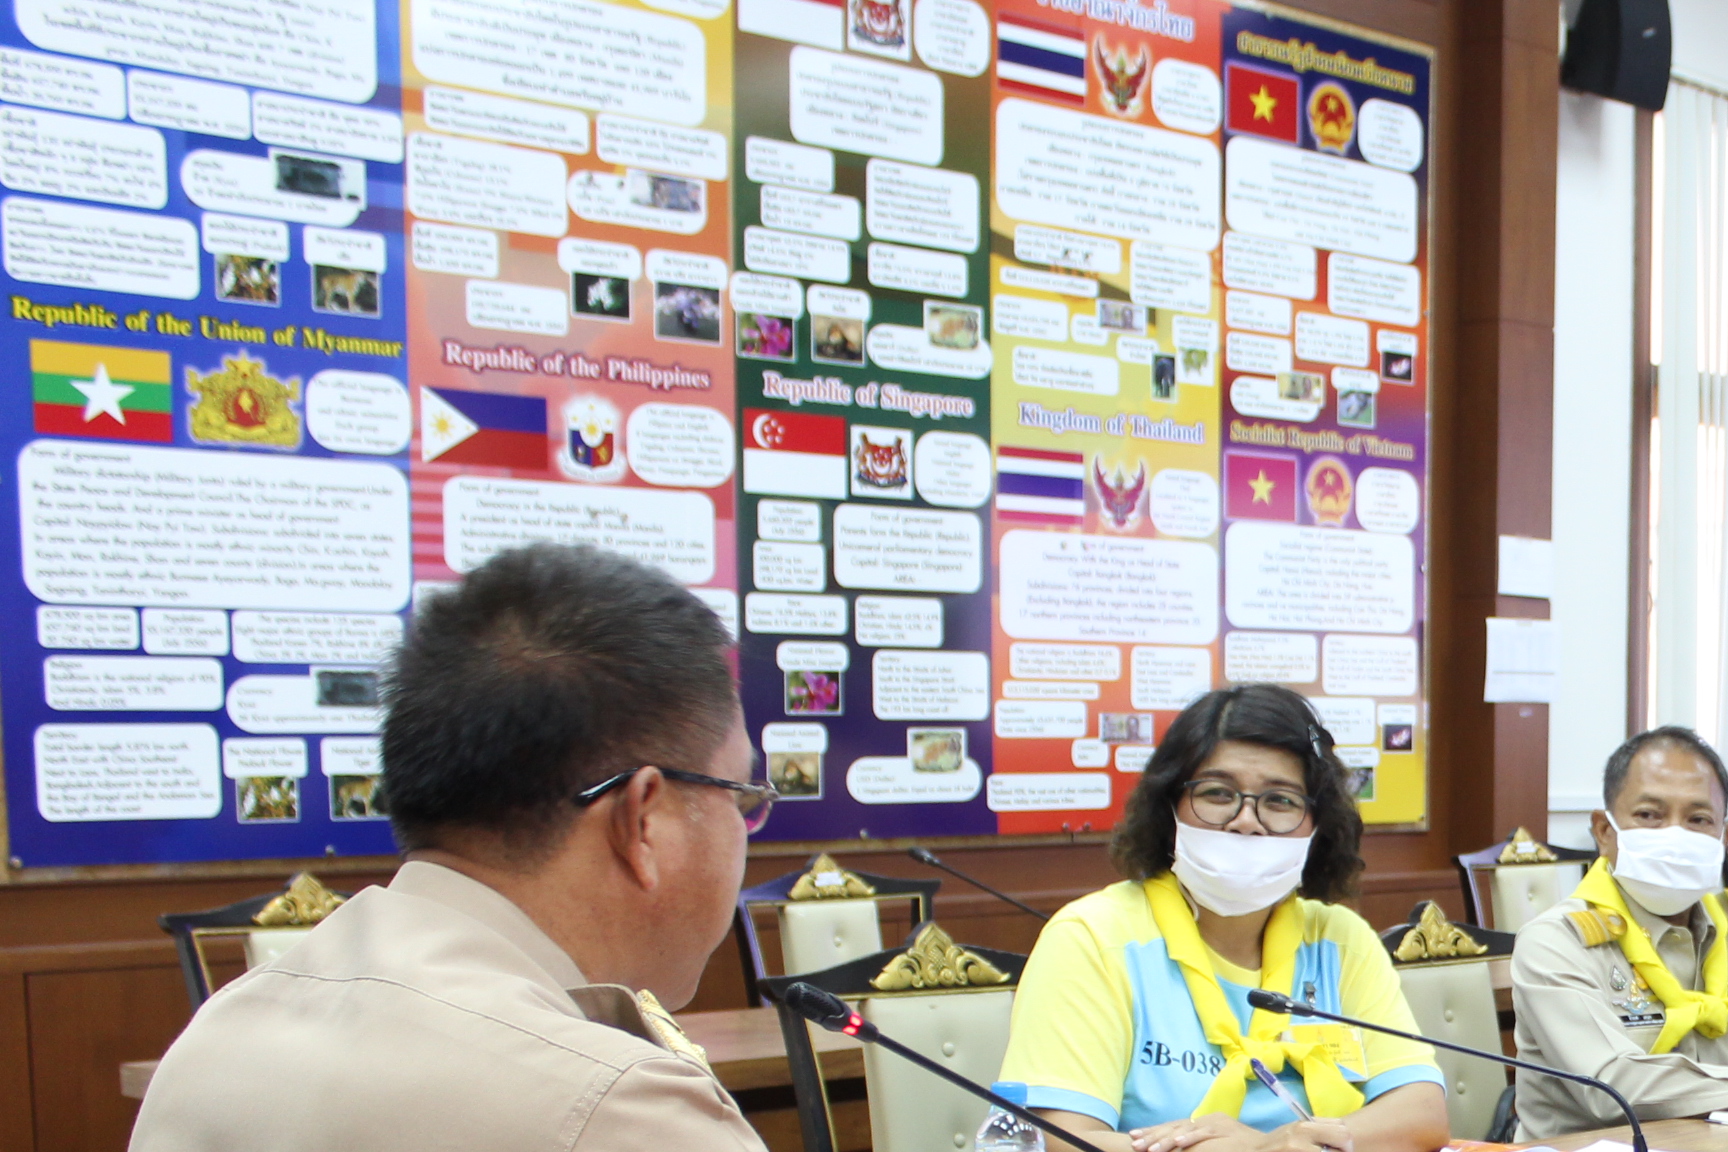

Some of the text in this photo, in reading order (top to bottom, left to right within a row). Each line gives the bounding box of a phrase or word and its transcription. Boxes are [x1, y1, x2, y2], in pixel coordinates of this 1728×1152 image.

[11, 295, 403, 358] Republic of the Union of Myanmar
[445, 342, 711, 390] Republic of the Philippines
[762, 370, 975, 418] Republic of Singapore
[1018, 403, 1205, 443] Kingdom of Thailand
[1230, 420, 1415, 461] Socialist Republic of Vietnam
[1140, 1040, 1221, 1077] 5B-038
